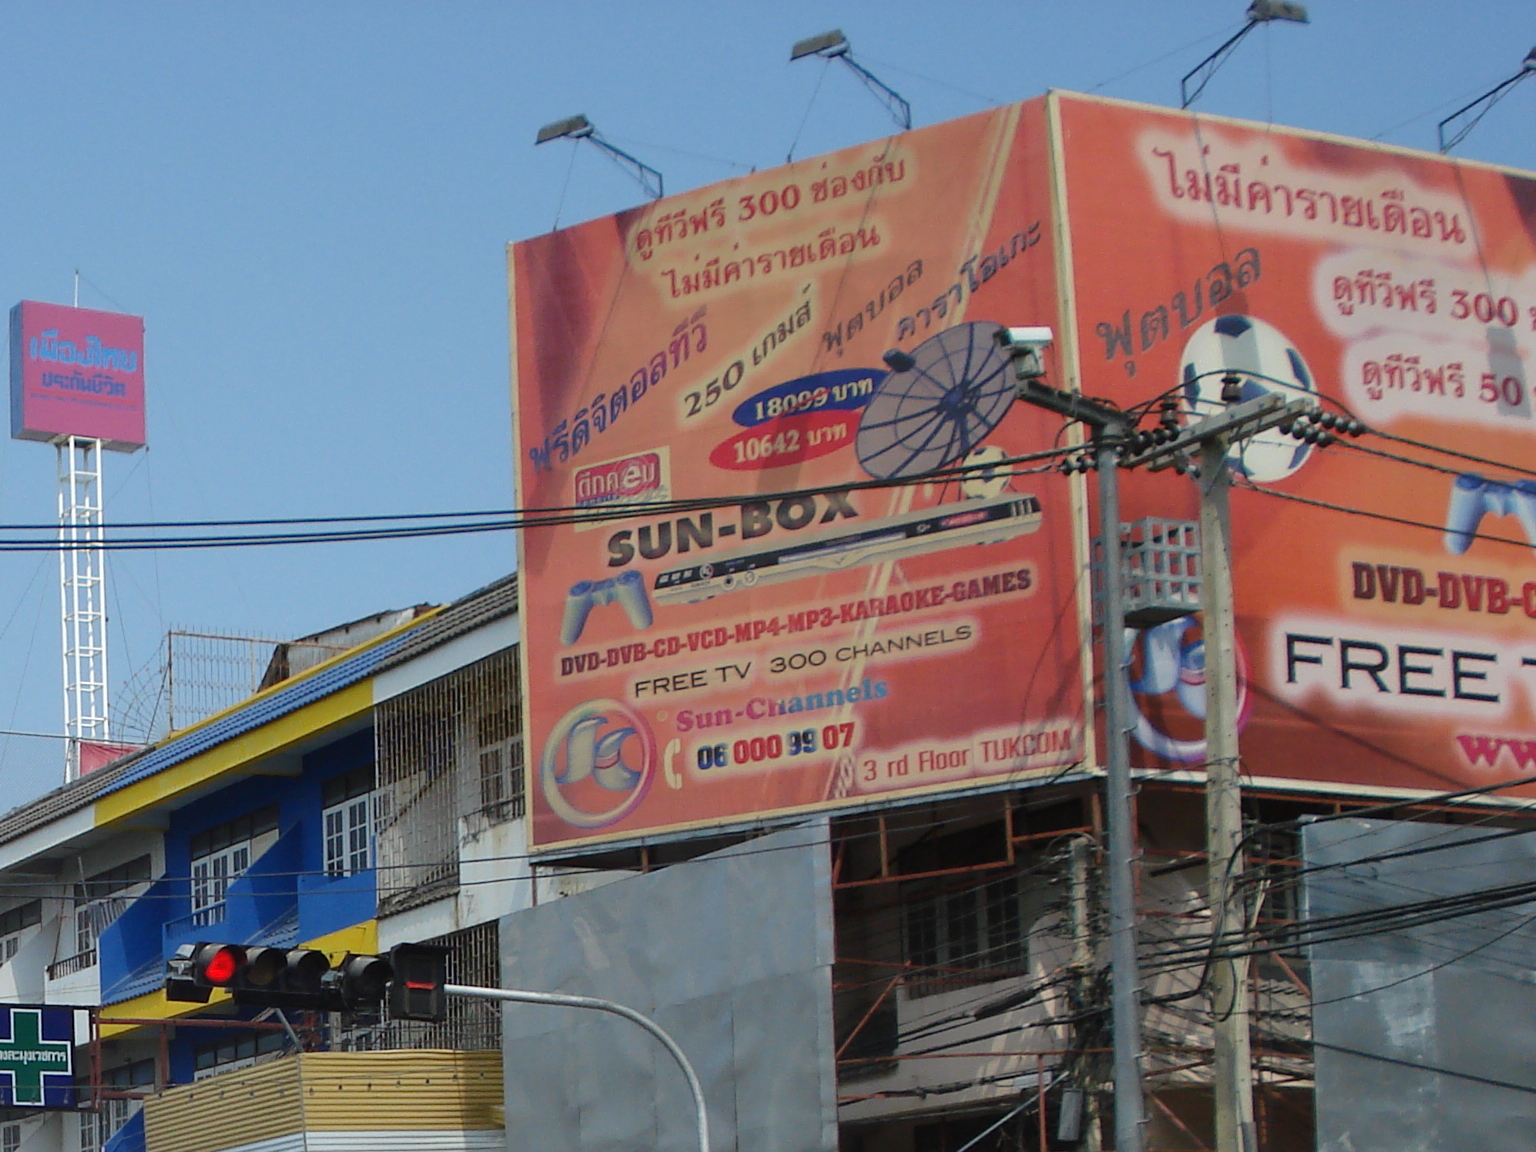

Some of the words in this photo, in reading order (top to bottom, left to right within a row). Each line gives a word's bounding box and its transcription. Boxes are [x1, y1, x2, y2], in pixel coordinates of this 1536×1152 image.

[736, 183, 801, 227] 300
[811, 152, 906, 202] ช่องกับ
[1152, 143, 1465, 245] ไม่มีค่ารายเดือน
[661, 224, 881, 301] ไม่มีค่ารายเดือน
[896, 220, 1043, 341] คาราโอเกะ
[821, 258, 925, 356] ฟุตบอล
[1095, 247, 1262, 378] ฟุตบอล
[1450, 289, 1519, 327] 300
[29, 328, 137, 374] เมืองไทย
[42, 370, 126, 397] ประกันชีวิต
[683, 362, 745, 417] 250
[751, 283, 814, 367] เกมส์
[832, 377, 874, 402] บาท
[1479, 373, 1523, 407] 50
[733, 428, 800, 464] 10642
[806, 422, 847, 446] บาท
[607, 486, 860, 568] SUN-BOX
[560, 568, 1032, 677] DVD-DVB-CD-VCD-MP4-MP3-KARAOKE-GAMES
[633, 670, 710, 699] FREE
[714, 661, 752, 686] TV
[770, 647, 827, 674] 300
[836, 625, 973, 663] CHANNELS
[1285, 632, 1501, 703] FREE
[676, 677, 889, 733] Sun-Channels
[697, 744, 729, 772] 06
[733, 738, 782, 764] 000
[787, 730, 818, 756] 99
[822, 722, 855, 750] 07
[864, 760, 877, 781] 3
[887, 755, 909, 779] rd
[919, 748, 970, 774] Floor
[980, 728, 1072, 763] TUKCOM
